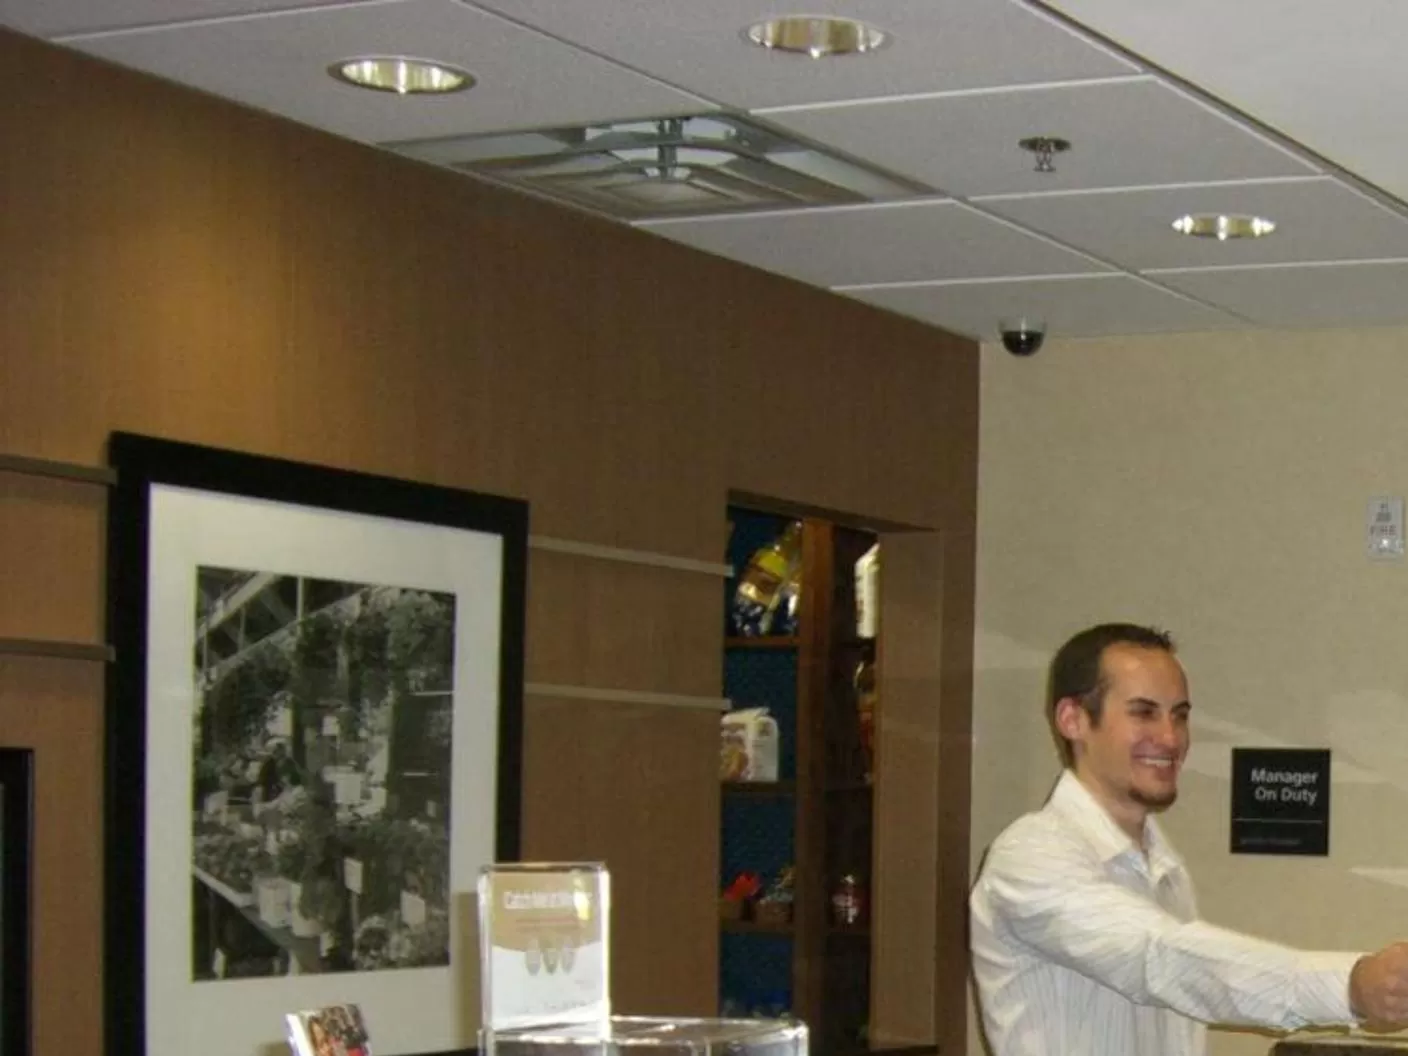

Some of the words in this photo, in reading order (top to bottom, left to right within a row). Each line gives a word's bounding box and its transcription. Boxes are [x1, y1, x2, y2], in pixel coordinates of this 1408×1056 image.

[1251, 767, 1319, 787] Manager
[1254, 786, 1277, 801] On
[1281, 786, 1318, 806] Duty
